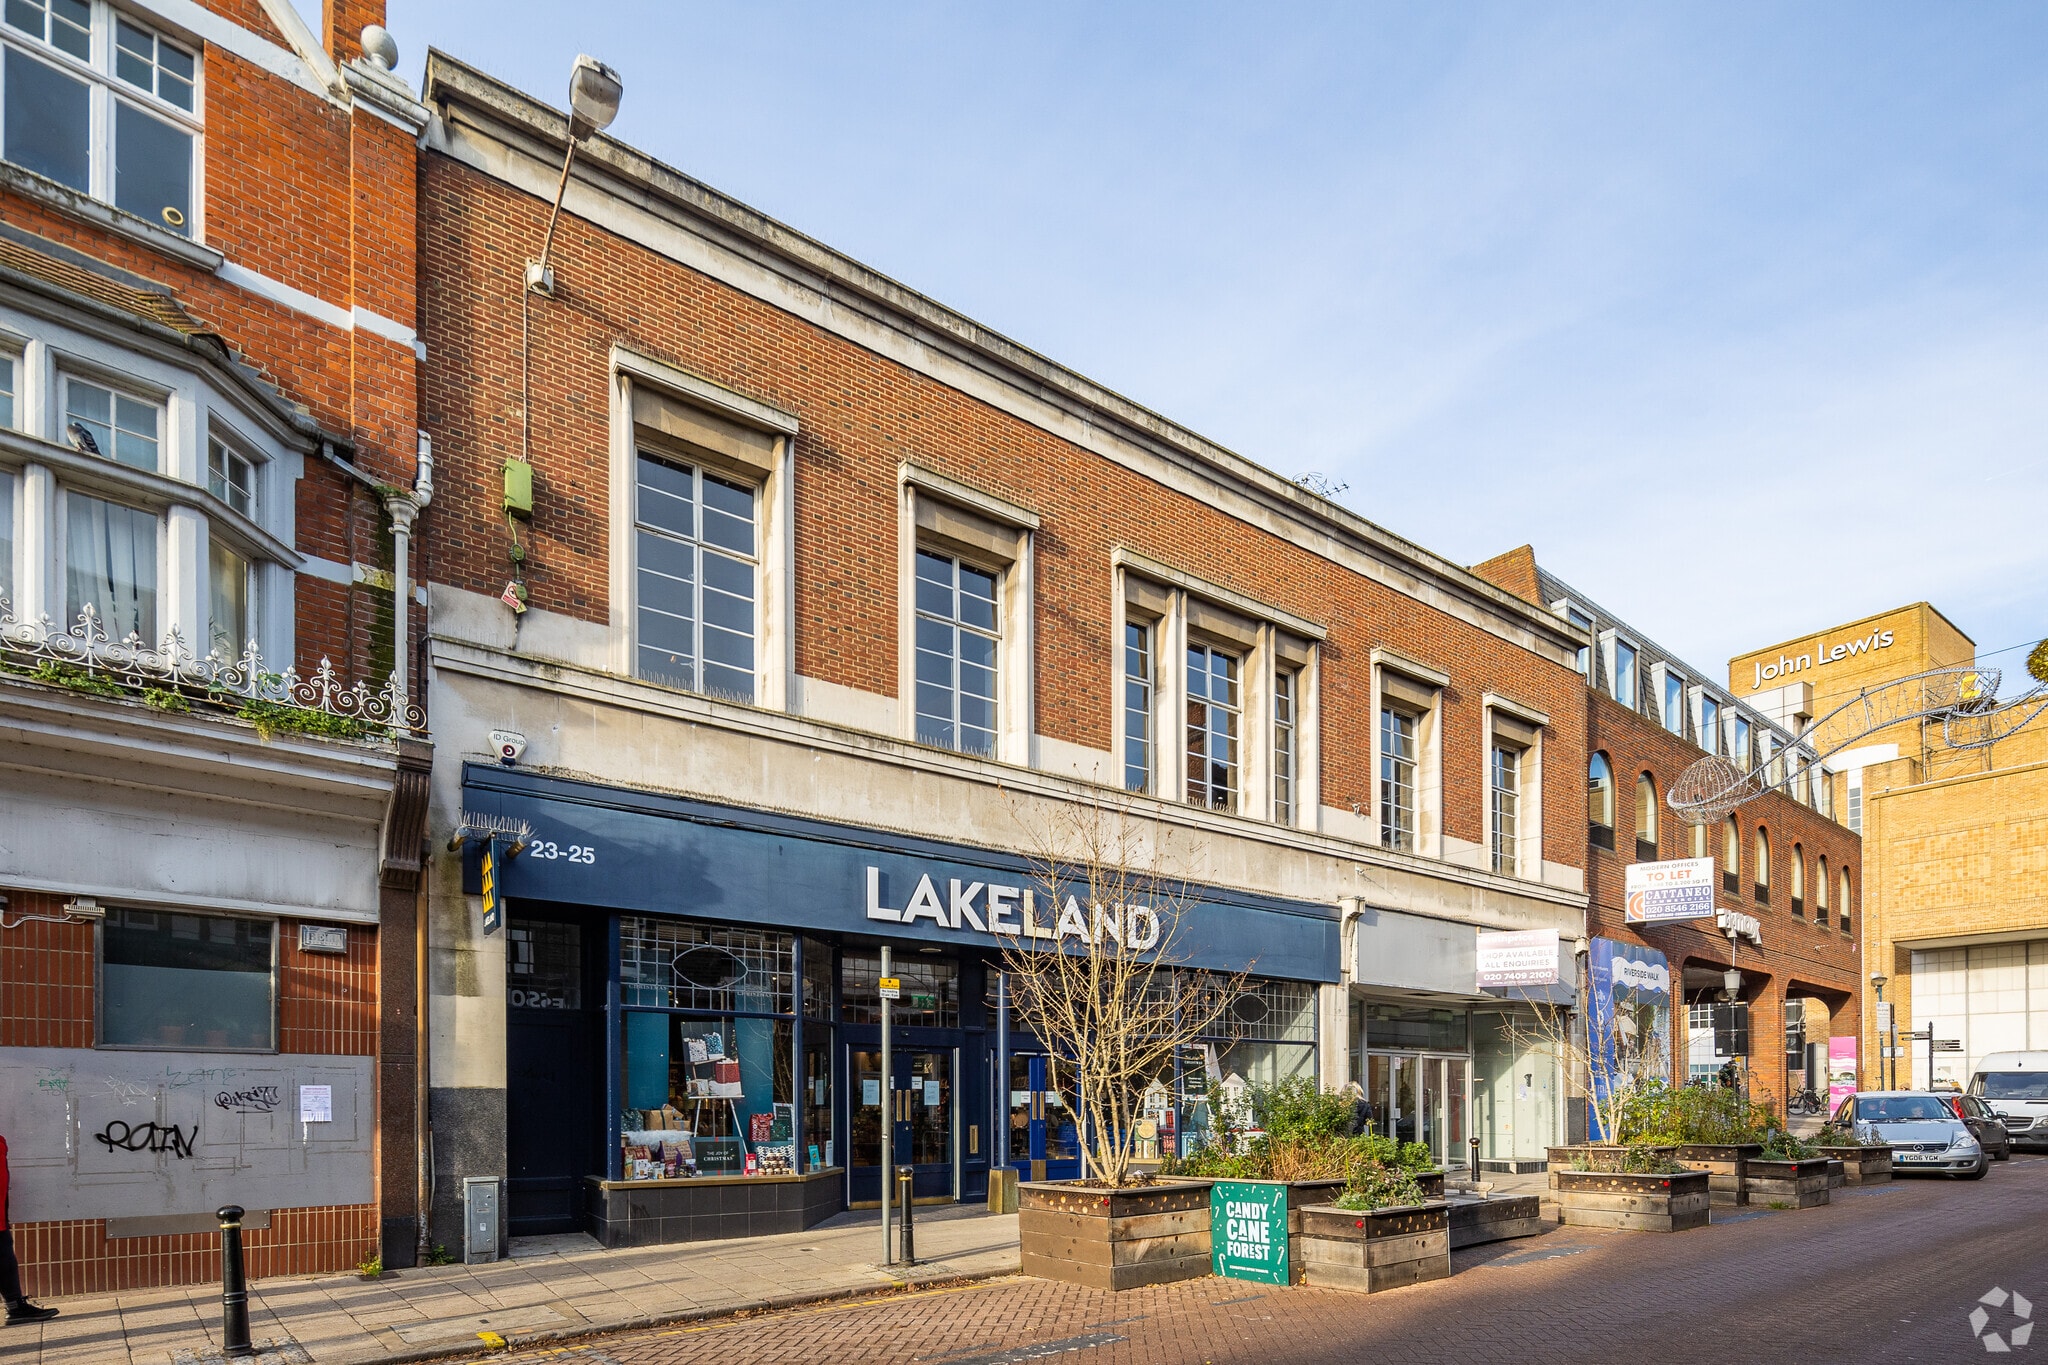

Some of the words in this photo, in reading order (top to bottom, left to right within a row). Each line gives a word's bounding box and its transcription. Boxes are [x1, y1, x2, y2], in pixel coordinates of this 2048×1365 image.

[1752, 654, 1811, 689] John
[1818, 628, 1895, 665] Lewis
[530, 840, 596, 865] 23-25
[1640, 864, 1670, 872] MODERN
[1646, 872, 1665, 882] TO
[1670, 870, 1692, 880] LET
[1645, 887, 1711, 900] CATTANEO
[866, 866, 1160, 950] LAKELAND
[1646, 906, 1663, 914] 020
[1665, 904, 1688, 913] 8546
[1690, 903, 1710, 911] 2166
[1505, 949, 1554, 958] AVAILABLE
[1485, 961, 1501, 969] ALL
[1503, 959, 1550, 968] ENQUIRIES
[1483, 973, 1502, 981] 020
[1503, 972, 1527, 981] 7409
[1529, 971, 1553, 979] 2100
[1624, 967, 1648, 979] RIVERSIDE
[1647, 970, 1660, 981] WALK
[1225, 1200, 1270, 1220] CANDY
[1226, 1218, 1271, 1244] CANE
[1226, 1240, 1271, 1261] FOREST
